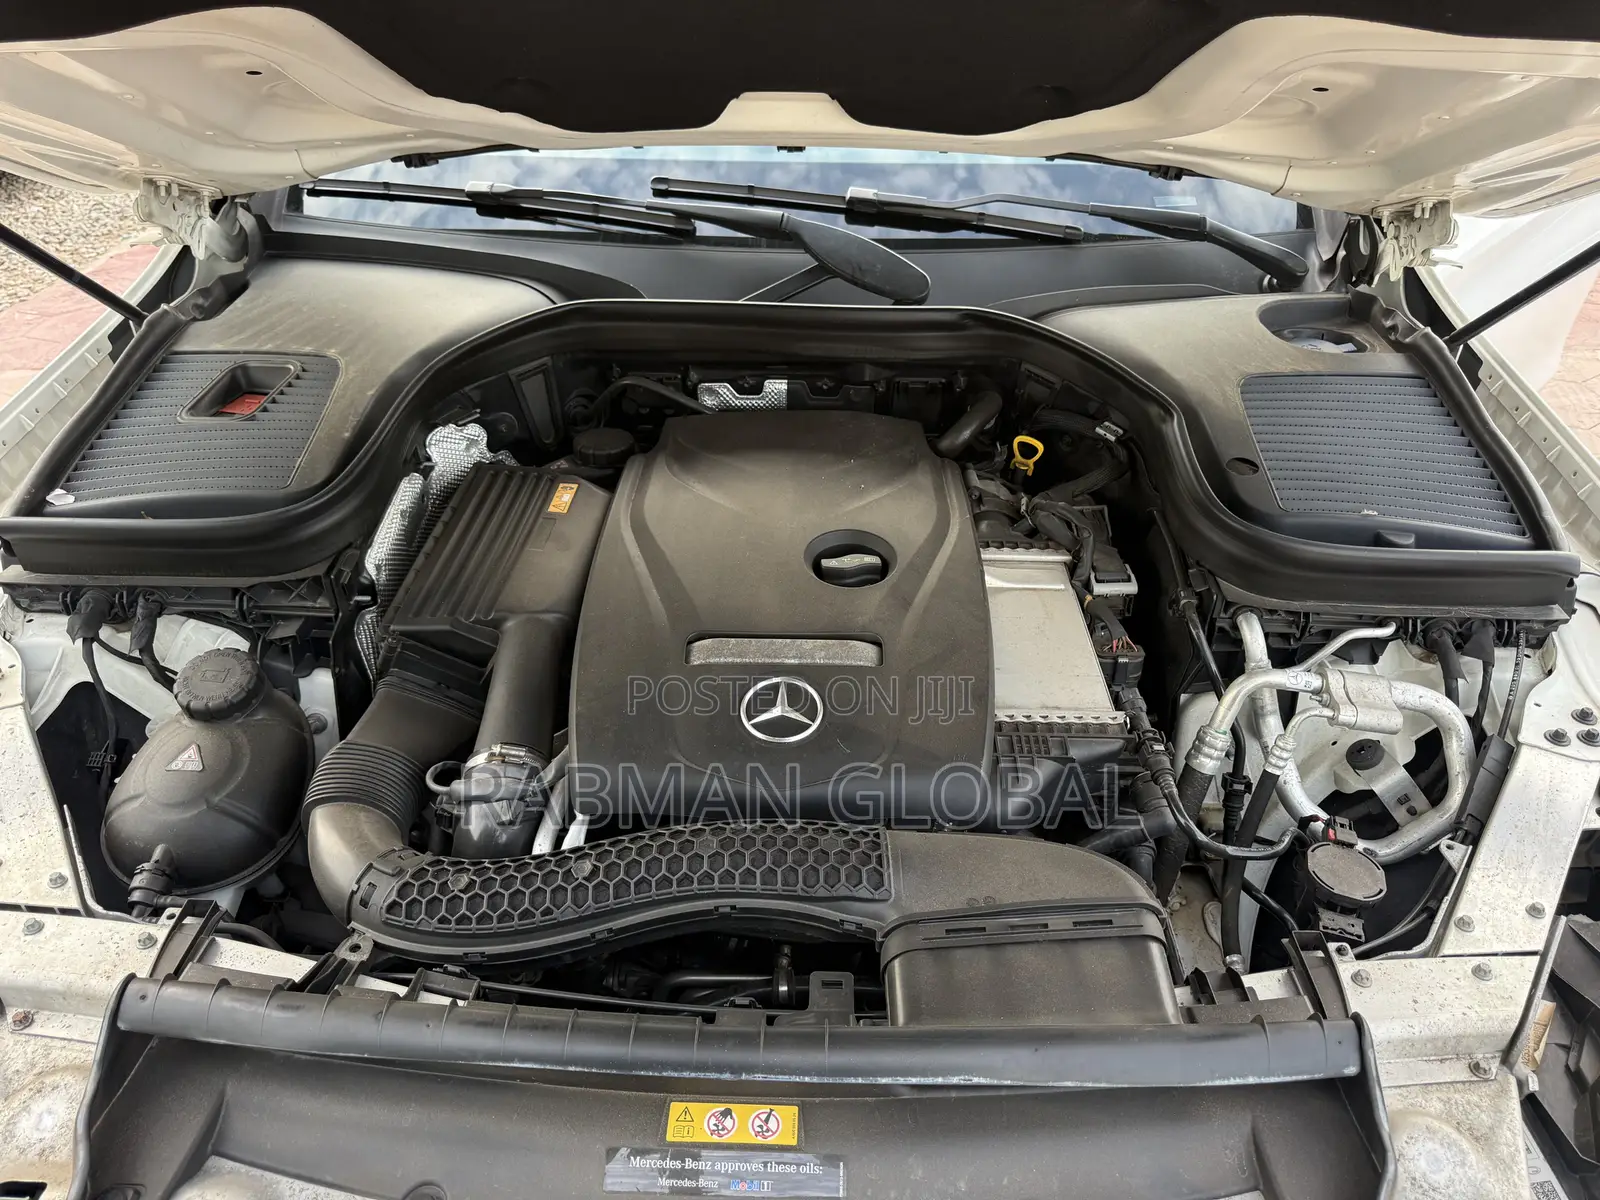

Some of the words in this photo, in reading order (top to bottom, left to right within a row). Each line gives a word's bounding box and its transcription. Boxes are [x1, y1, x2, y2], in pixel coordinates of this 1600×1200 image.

[629, 1156, 712, 1170] Mercedes-Benz
[714, 1161, 764, 1174] approves
[767, 1161, 797, 1174] these
[799, 1162, 823, 1175] oils:
[657, 1176, 719, 1188] Mercedes-Benz
[730, 1180, 760, 1192] Mobil
